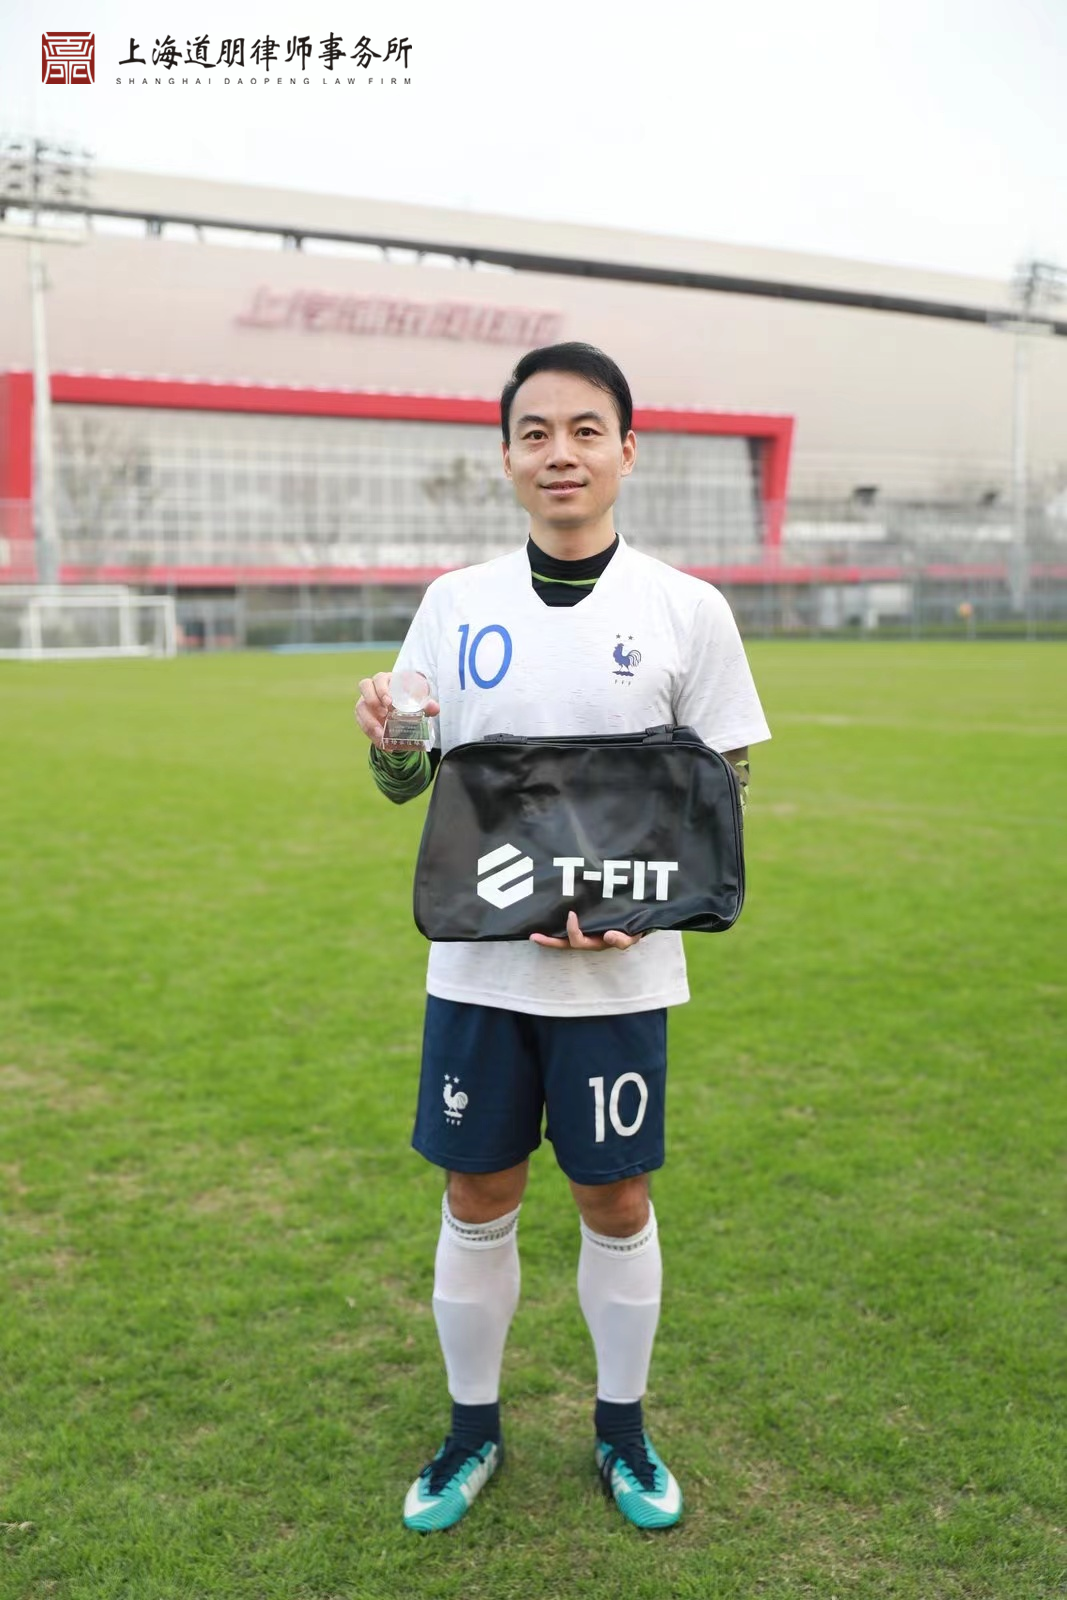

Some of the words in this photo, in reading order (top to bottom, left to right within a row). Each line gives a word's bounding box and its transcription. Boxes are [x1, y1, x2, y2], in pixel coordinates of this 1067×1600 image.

[458, 624, 513, 690] 10
[553, 857, 679, 901] T-FIT
[588, 1072, 648, 1143] 10
